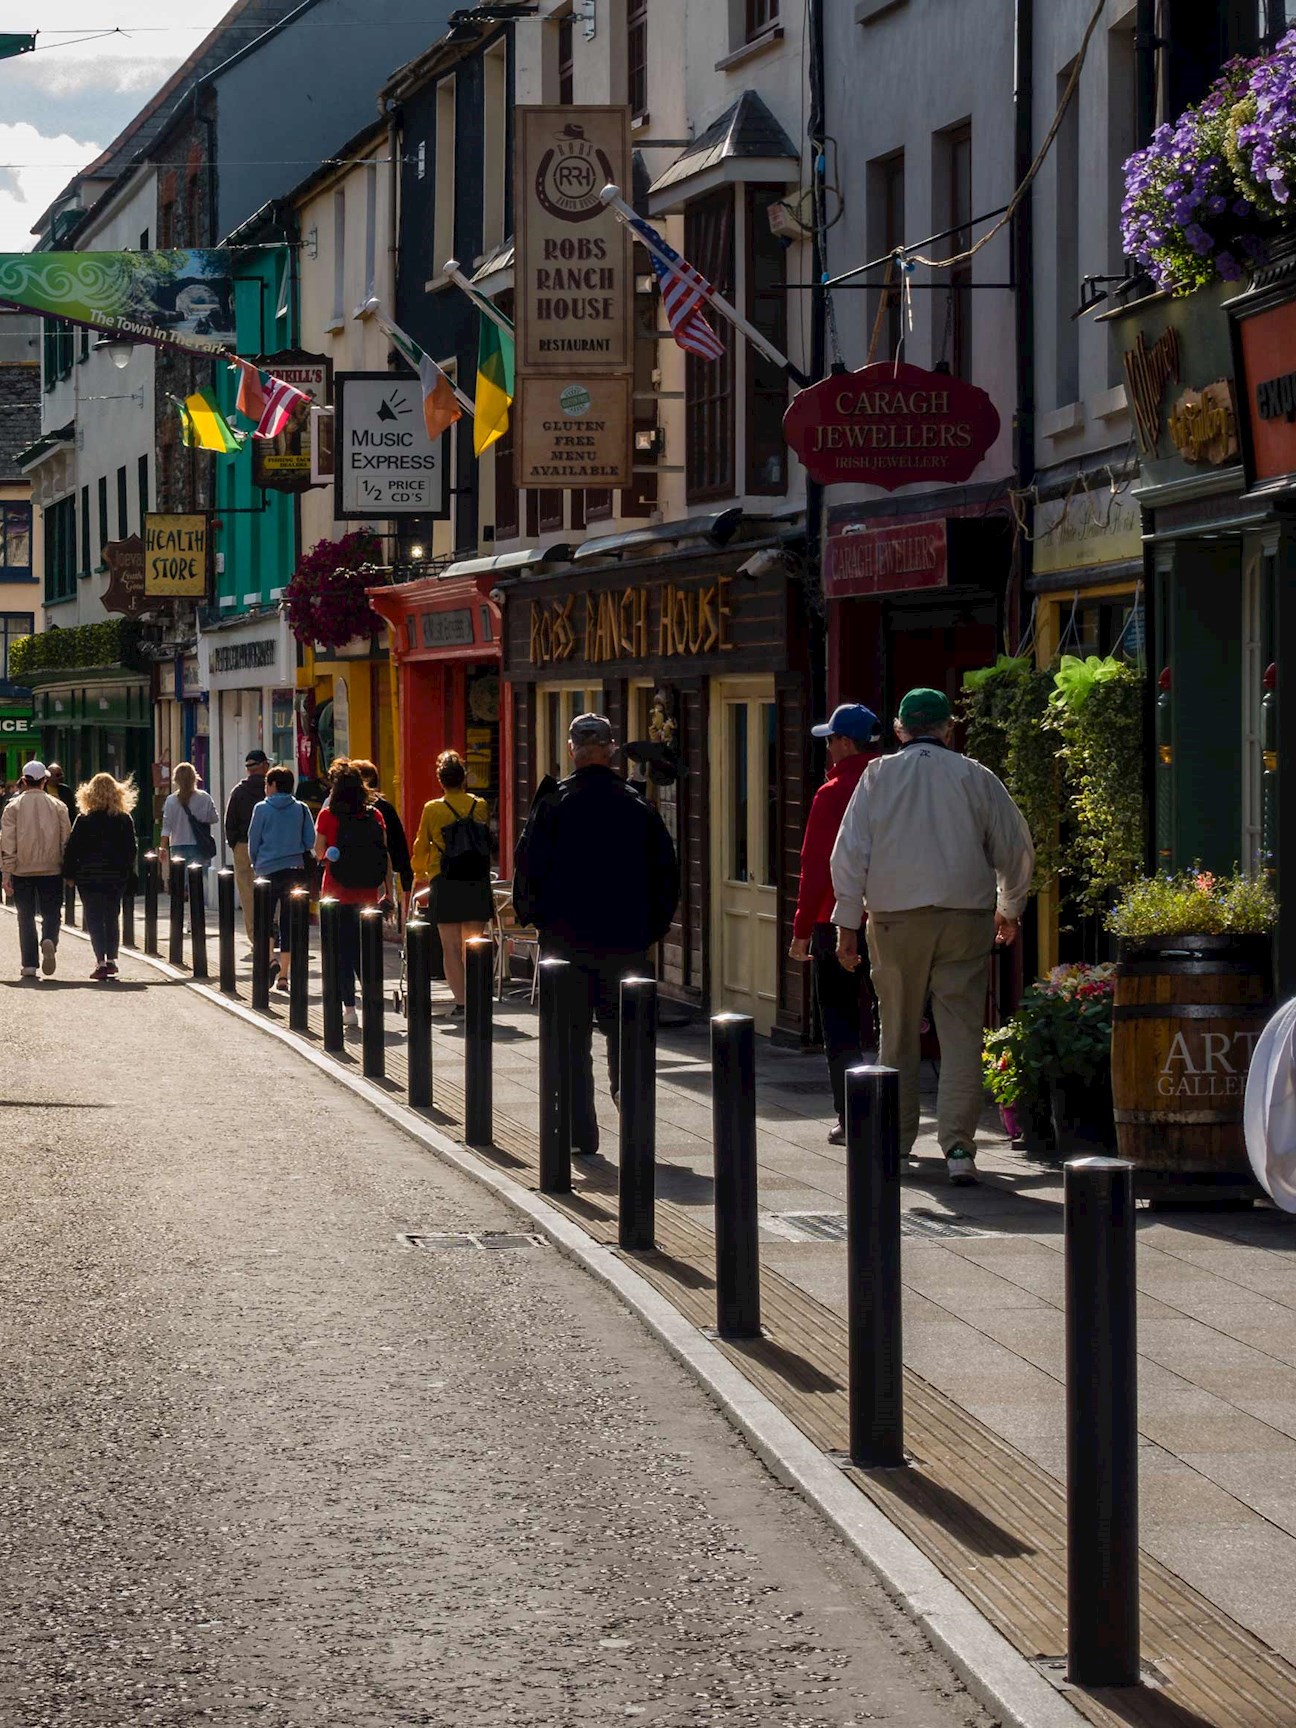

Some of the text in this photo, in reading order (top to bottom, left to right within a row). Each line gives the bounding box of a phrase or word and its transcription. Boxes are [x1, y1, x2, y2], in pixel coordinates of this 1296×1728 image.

[544, 238, 607, 261] ROBS
[536, 267, 615, 291] RANCH
[537, 297, 615, 320] HOUSE
[90, 309, 226, 355] The Town in The Park
[539, 339, 611, 351] RESTAURANT
[835, 391, 950, 416] CARAGH
[1256, 371, 1296, 424] exp
[542, 421, 606, 431] GLUTEN
[352, 429, 413, 447] MUSIC
[554, 436, 595, 446] FREE
[812, 424, 972, 452] JEWELLERS
[351, 452, 436, 470] EXPRESS
[551, 451, 597, 461] MENU
[835, 455, 950, 471] IRISH JEWELLERY
[530, 466, 619, 476] AVAILABLE
[362, 480, 425, 501] 1/2 PRICE
[391, 493, 422, 502] CD'S
[146, 529, 204, 552] HEALTH
[152, 557, 198, 580] STORE
[831, 535, 937, 581] CARAGH JEWELLERS
[1157, 1077, 1246, 1096] GALLE
